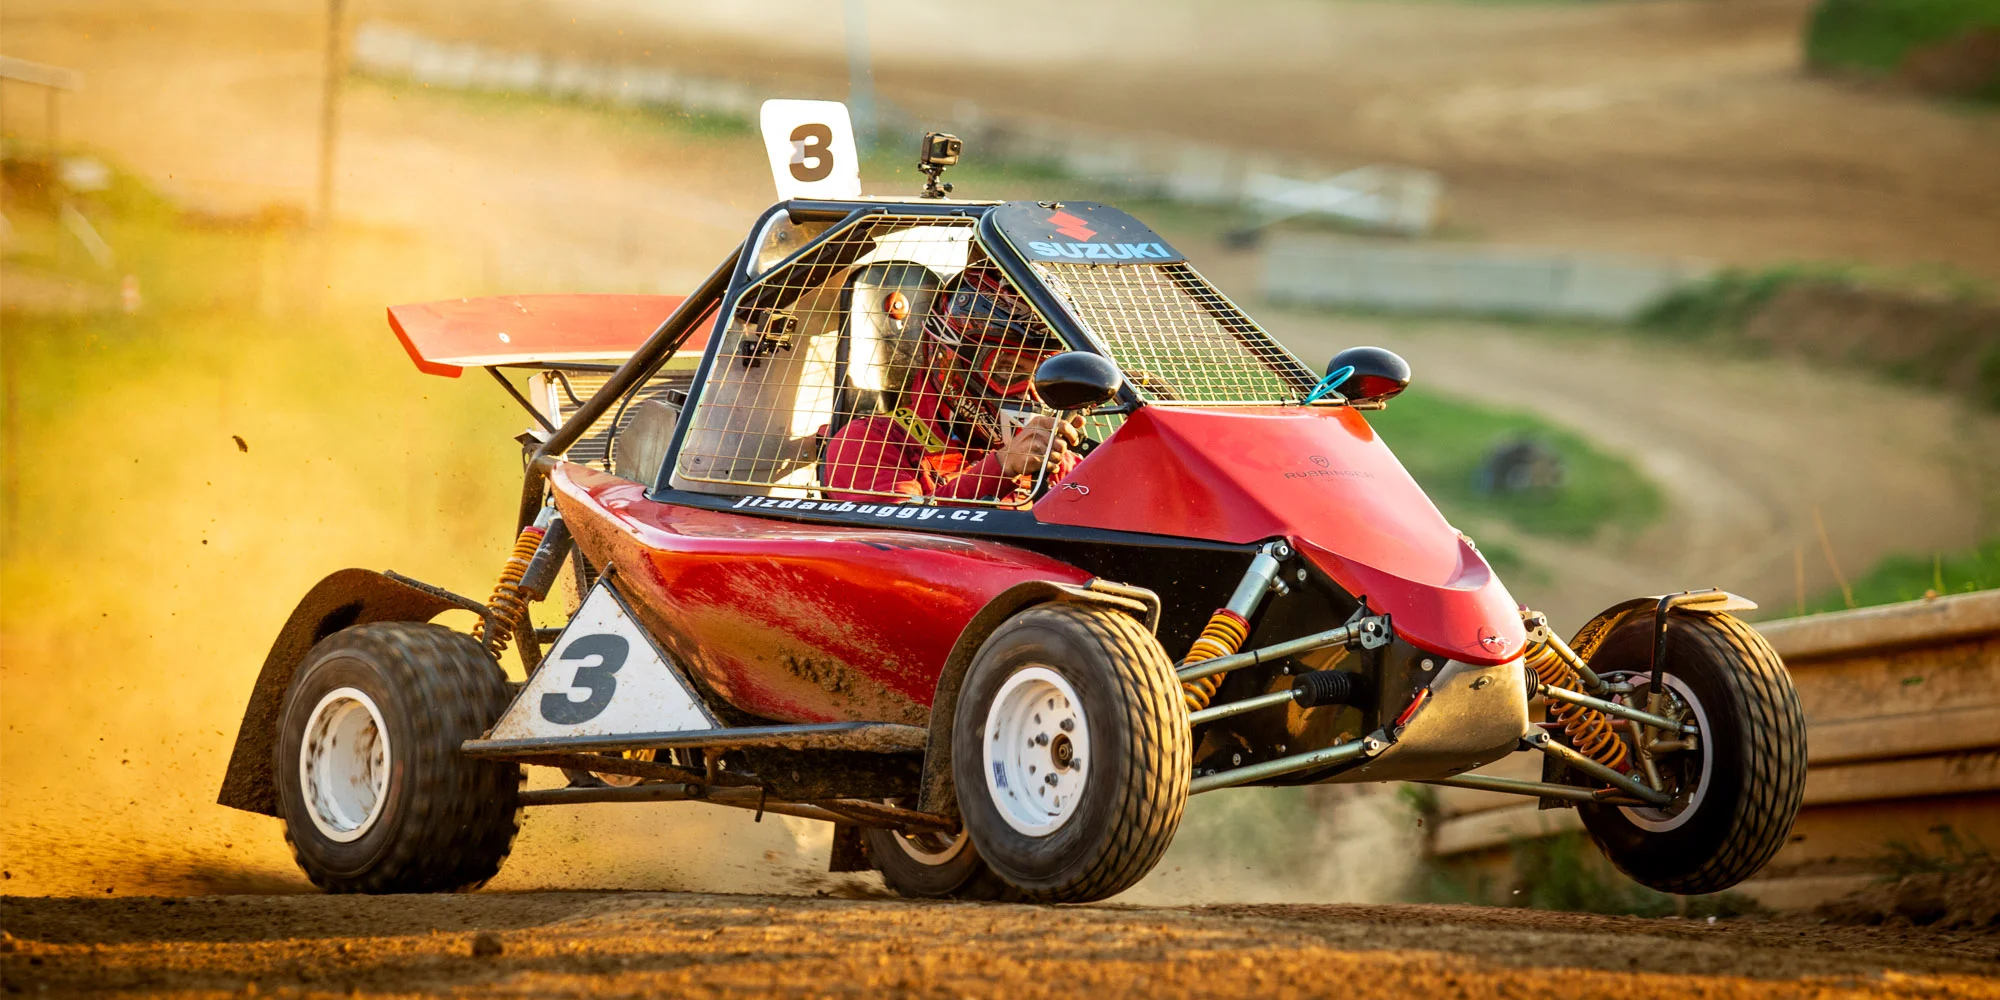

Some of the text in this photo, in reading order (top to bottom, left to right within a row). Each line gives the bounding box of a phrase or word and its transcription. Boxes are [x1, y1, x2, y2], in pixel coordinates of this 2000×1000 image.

[789, 123, 834, 182] 3
[1028, 241, 1172, 259] SUZUKI
[540, 633, 630, 725] 3
